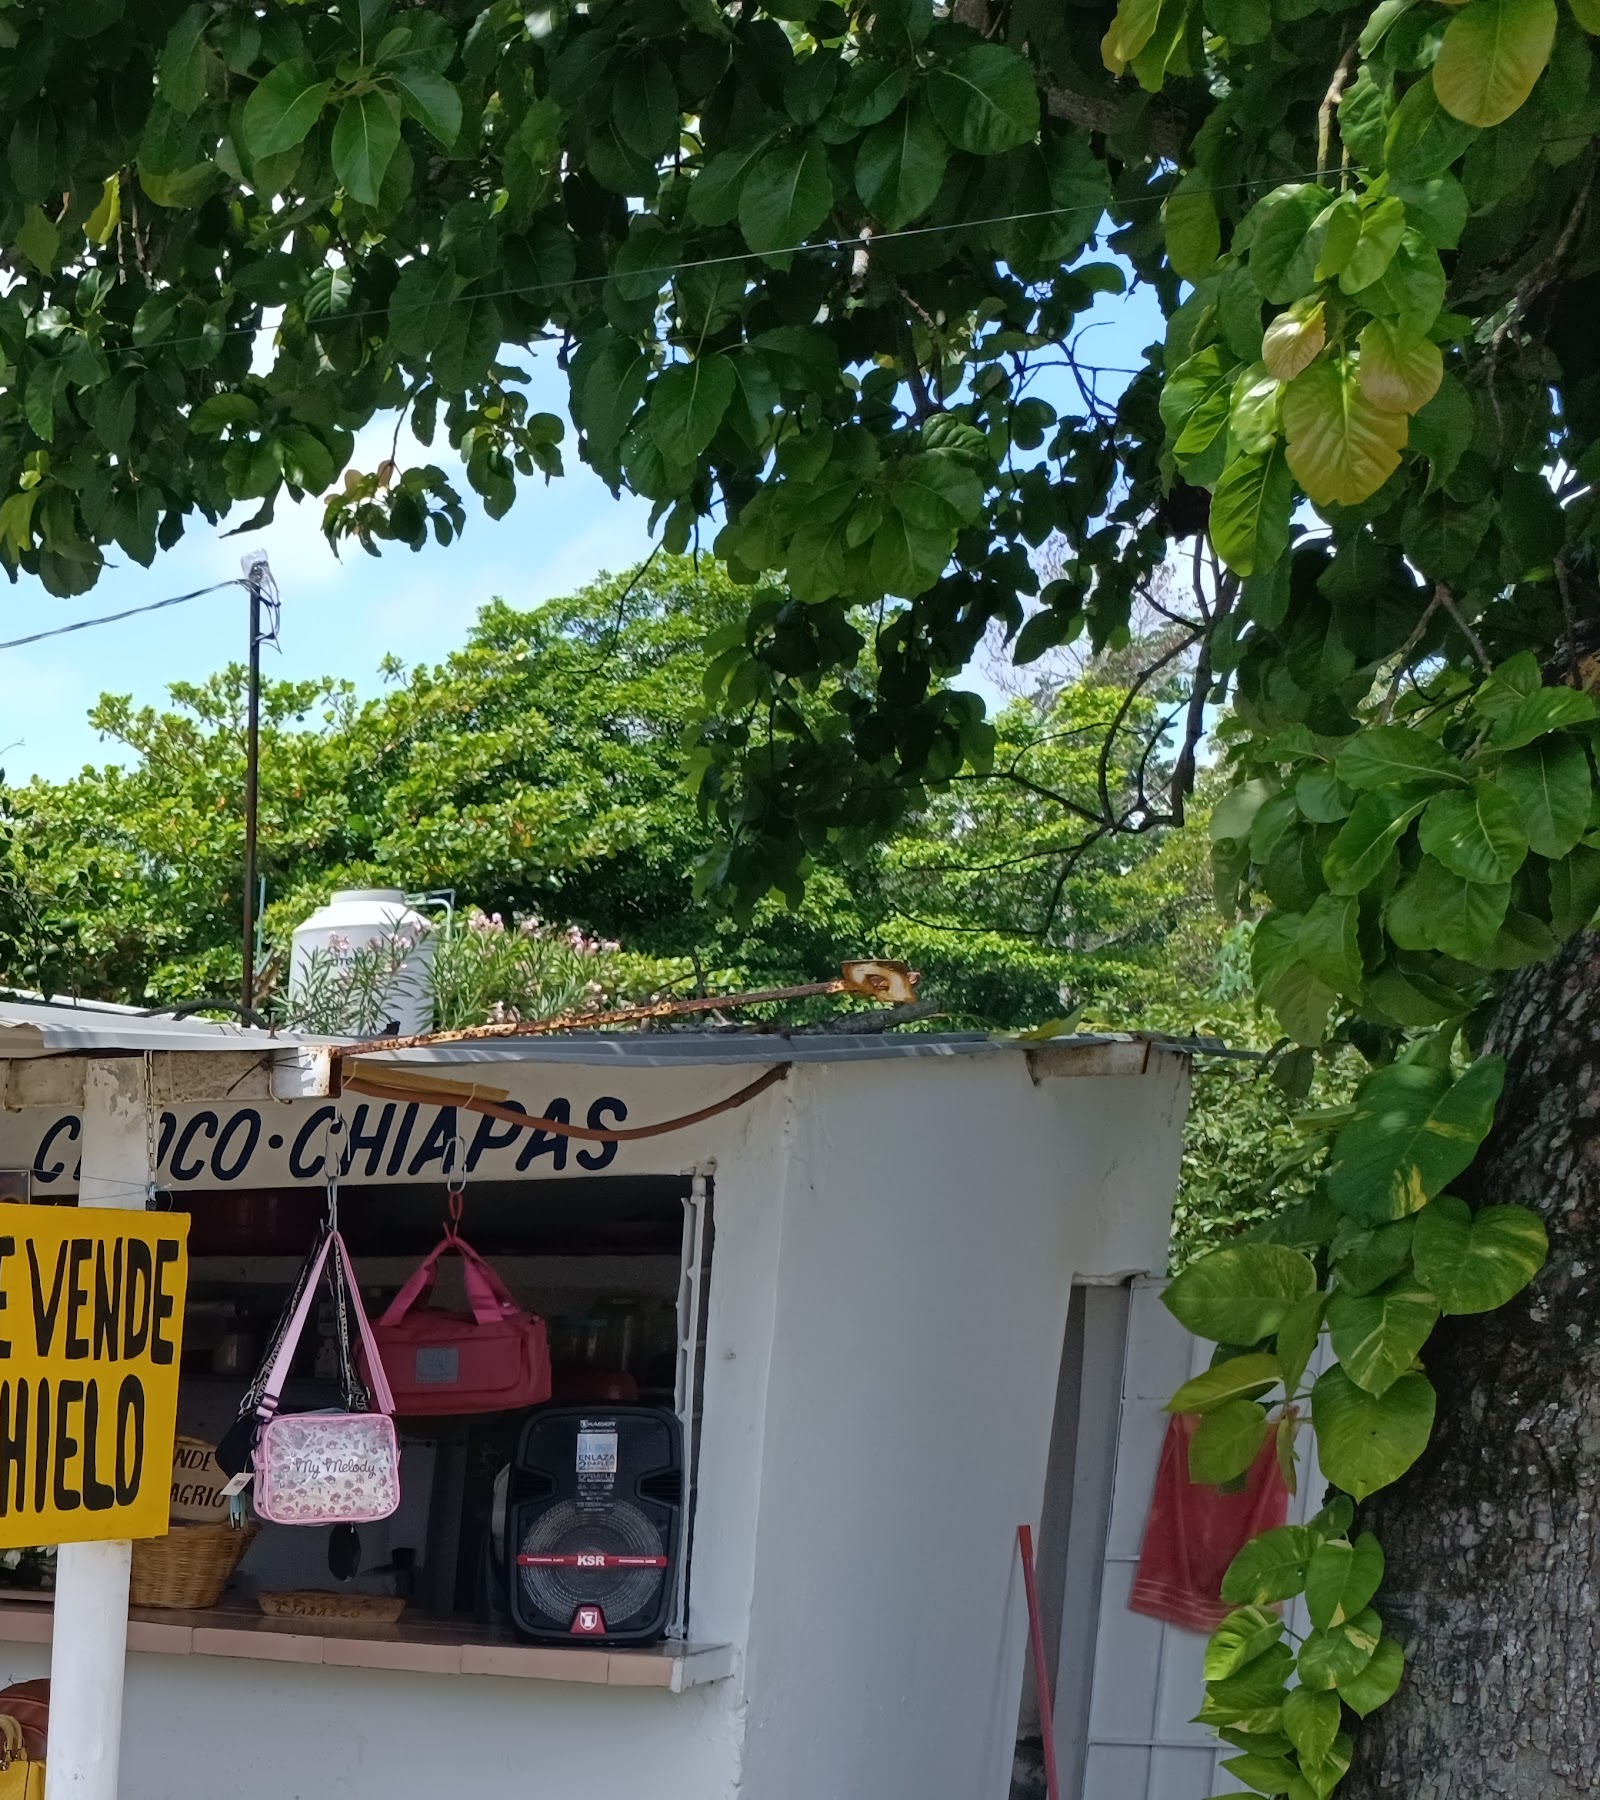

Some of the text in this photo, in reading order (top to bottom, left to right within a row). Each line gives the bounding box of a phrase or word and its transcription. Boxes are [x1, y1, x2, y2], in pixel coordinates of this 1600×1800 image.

[26, 1236, 179, 1365] VENDE
[292, 1457, 377, 1480] My Melody
[576, 1555, 605, 1567] KSR
